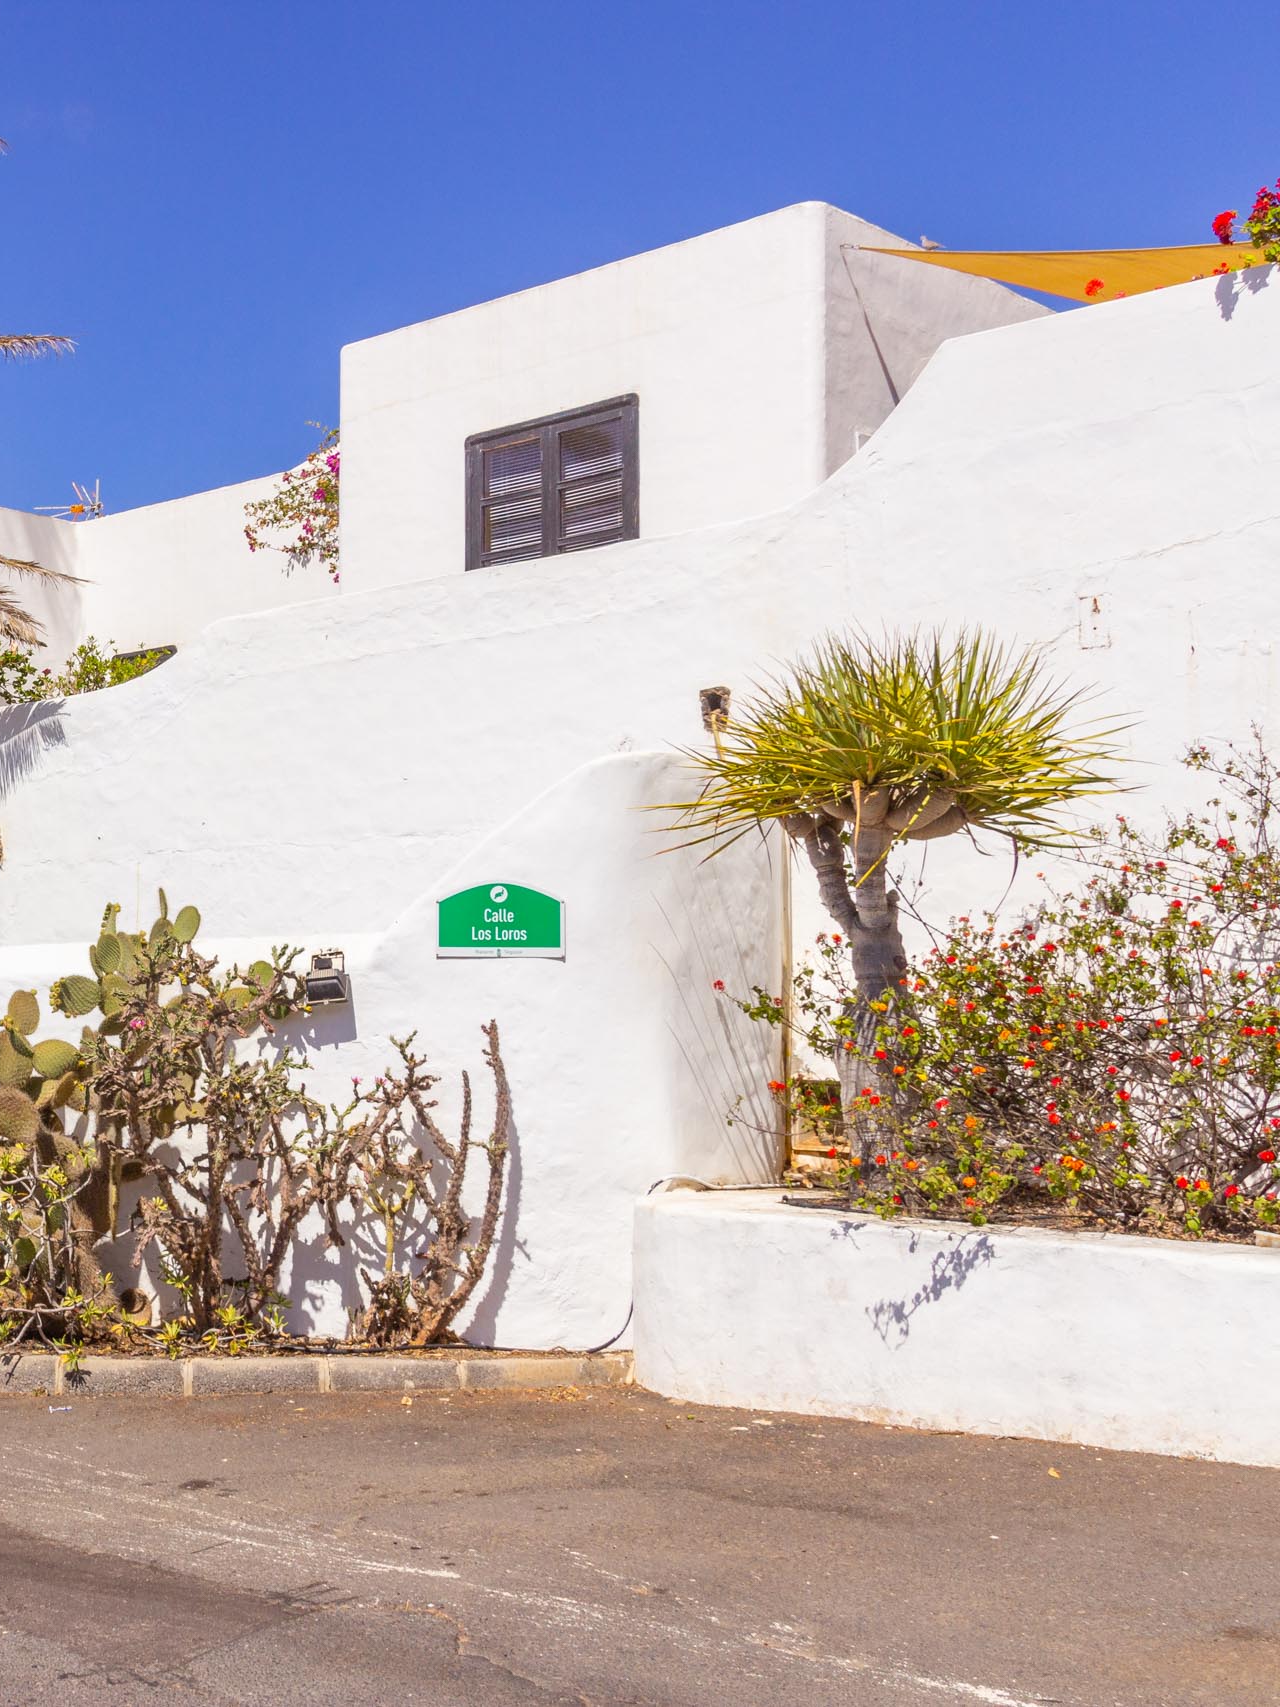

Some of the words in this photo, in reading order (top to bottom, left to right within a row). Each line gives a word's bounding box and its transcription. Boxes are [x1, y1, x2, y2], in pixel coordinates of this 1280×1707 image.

[484, 908, 514, 923] Calle
[471, 926, 492, 941] Los
[495, 926, 527, 941] Loros
